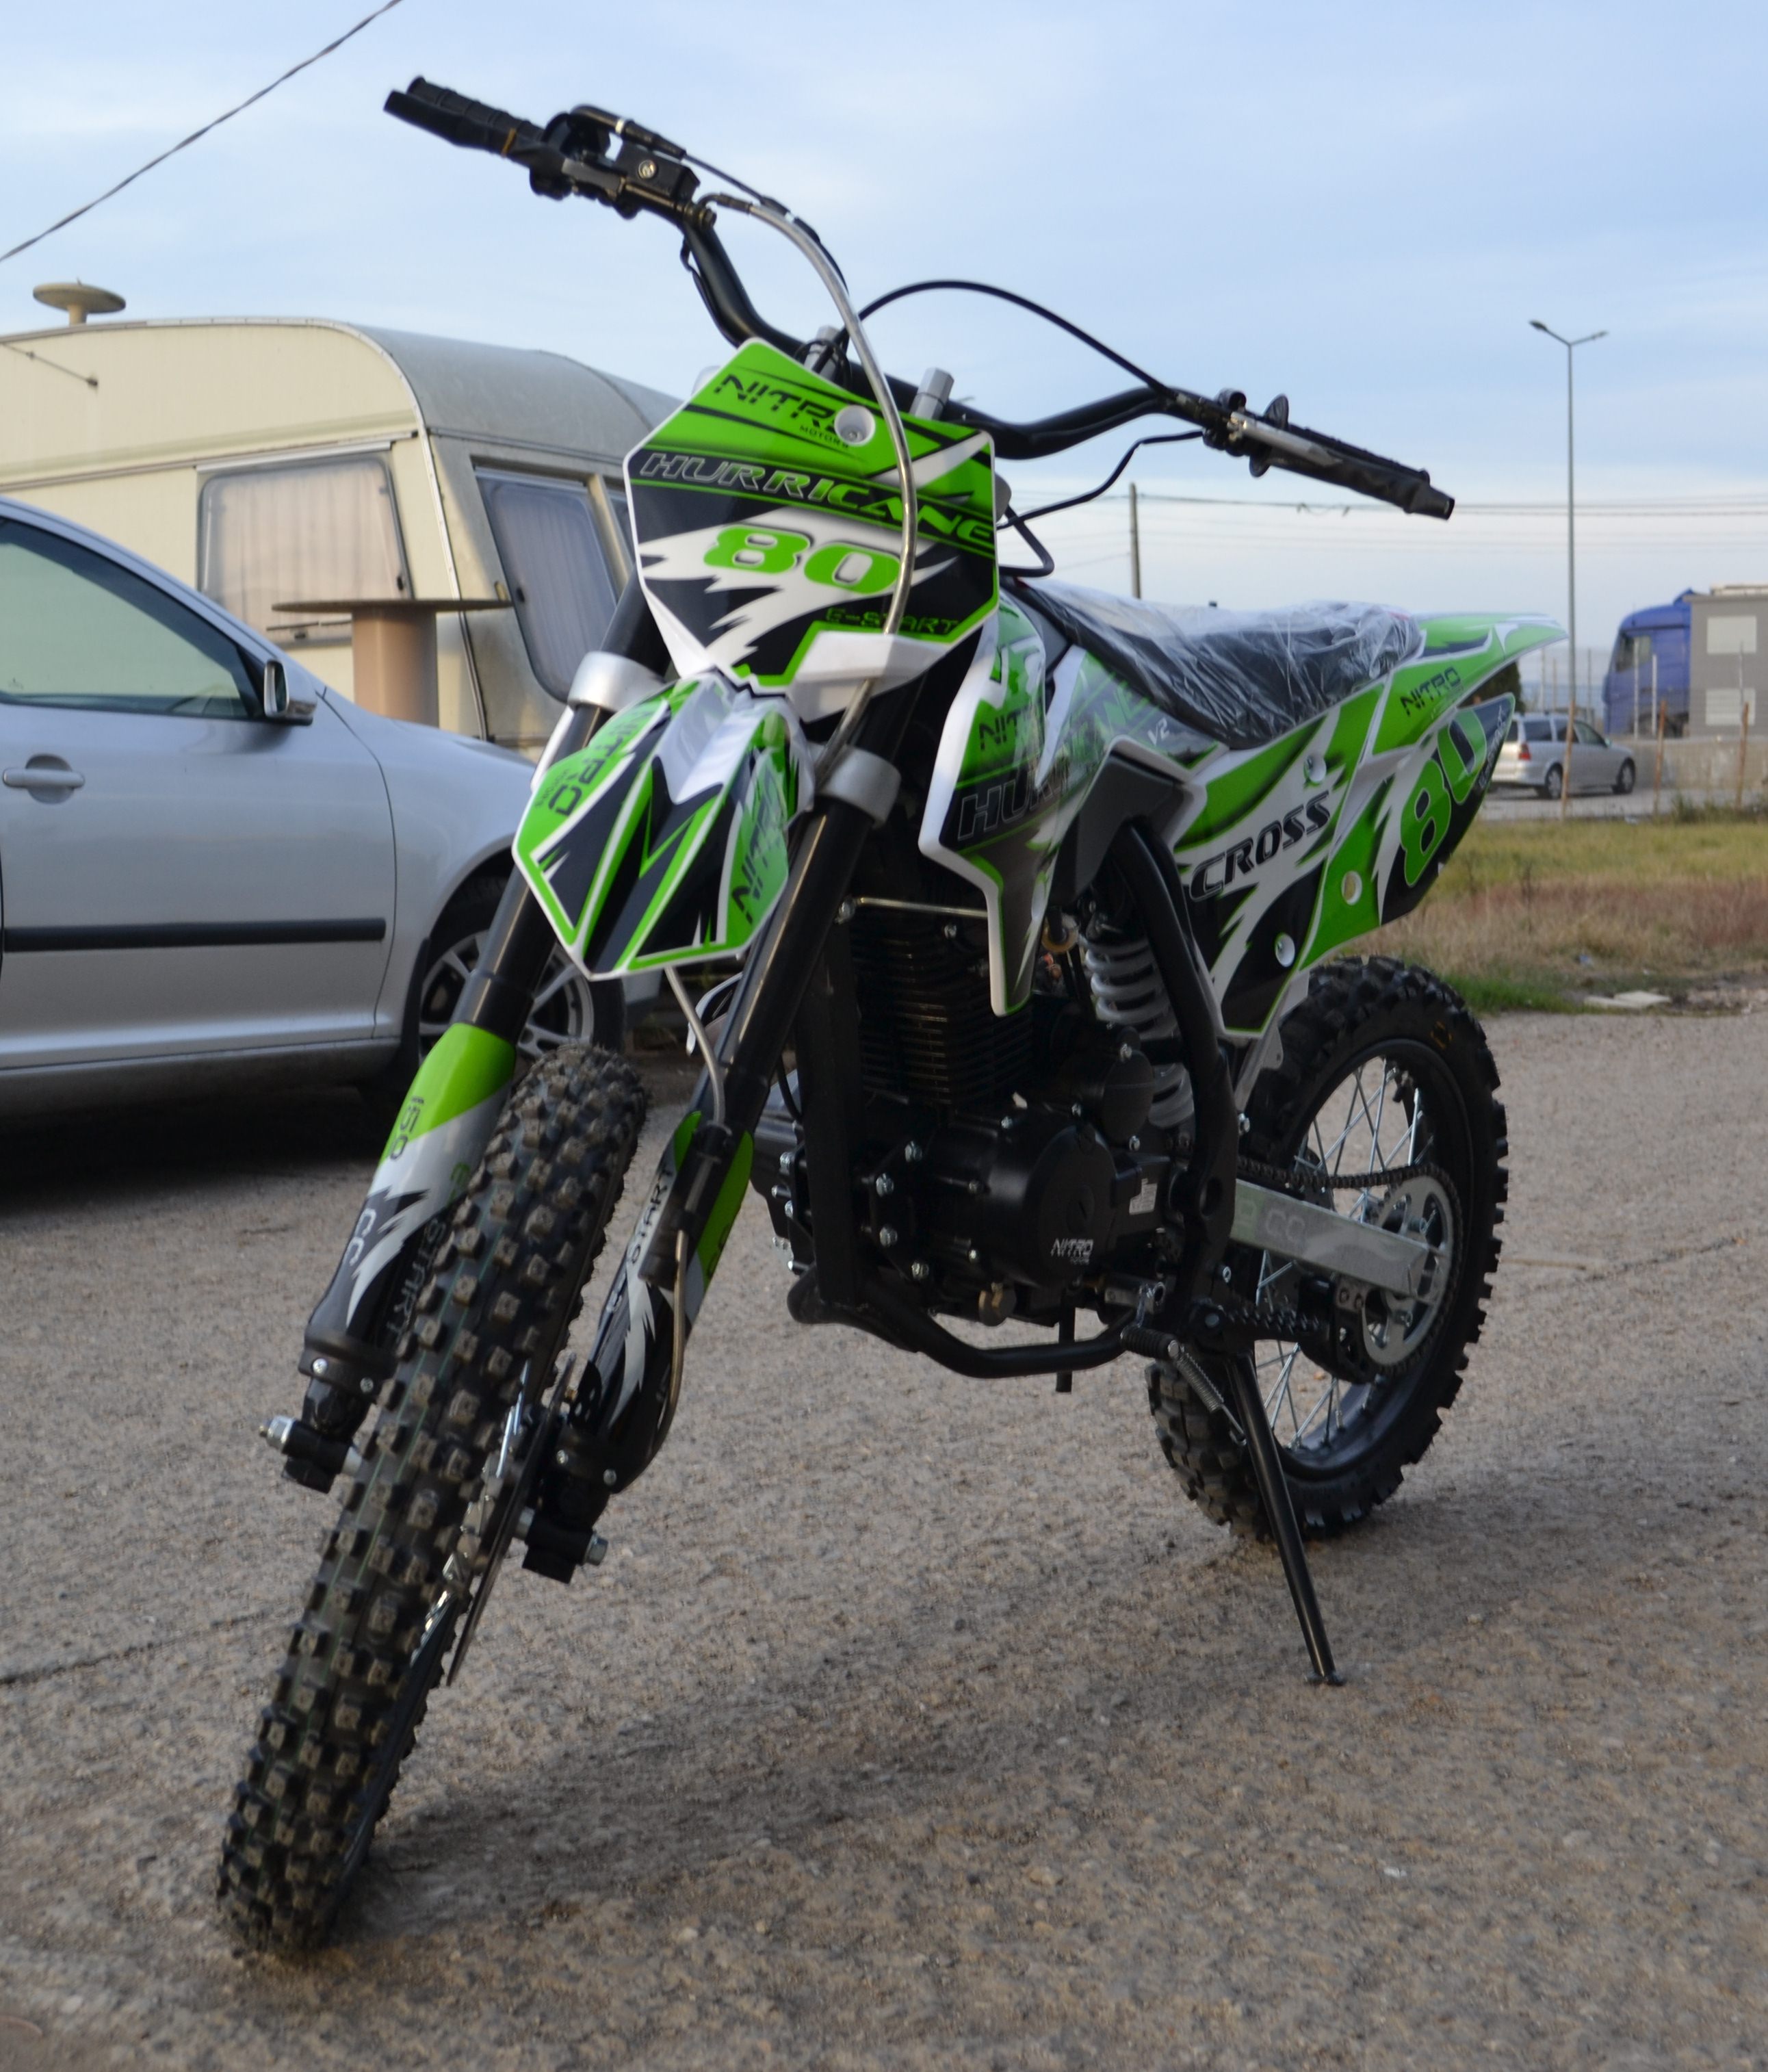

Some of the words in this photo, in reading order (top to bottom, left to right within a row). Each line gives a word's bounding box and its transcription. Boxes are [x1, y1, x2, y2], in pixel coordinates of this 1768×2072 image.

[640, 452, 994, 541] HURRICANE
[703, 526, 902, 594] 80
[826, 607, 959, 634] E-SART
[1400, 666, 1462, 716] NITRO
[1400, 708, 1487, 887] 80
[1189, 790, 1331, 903] CROSS
[1050, 1238, 1095, 1258] NITRO
